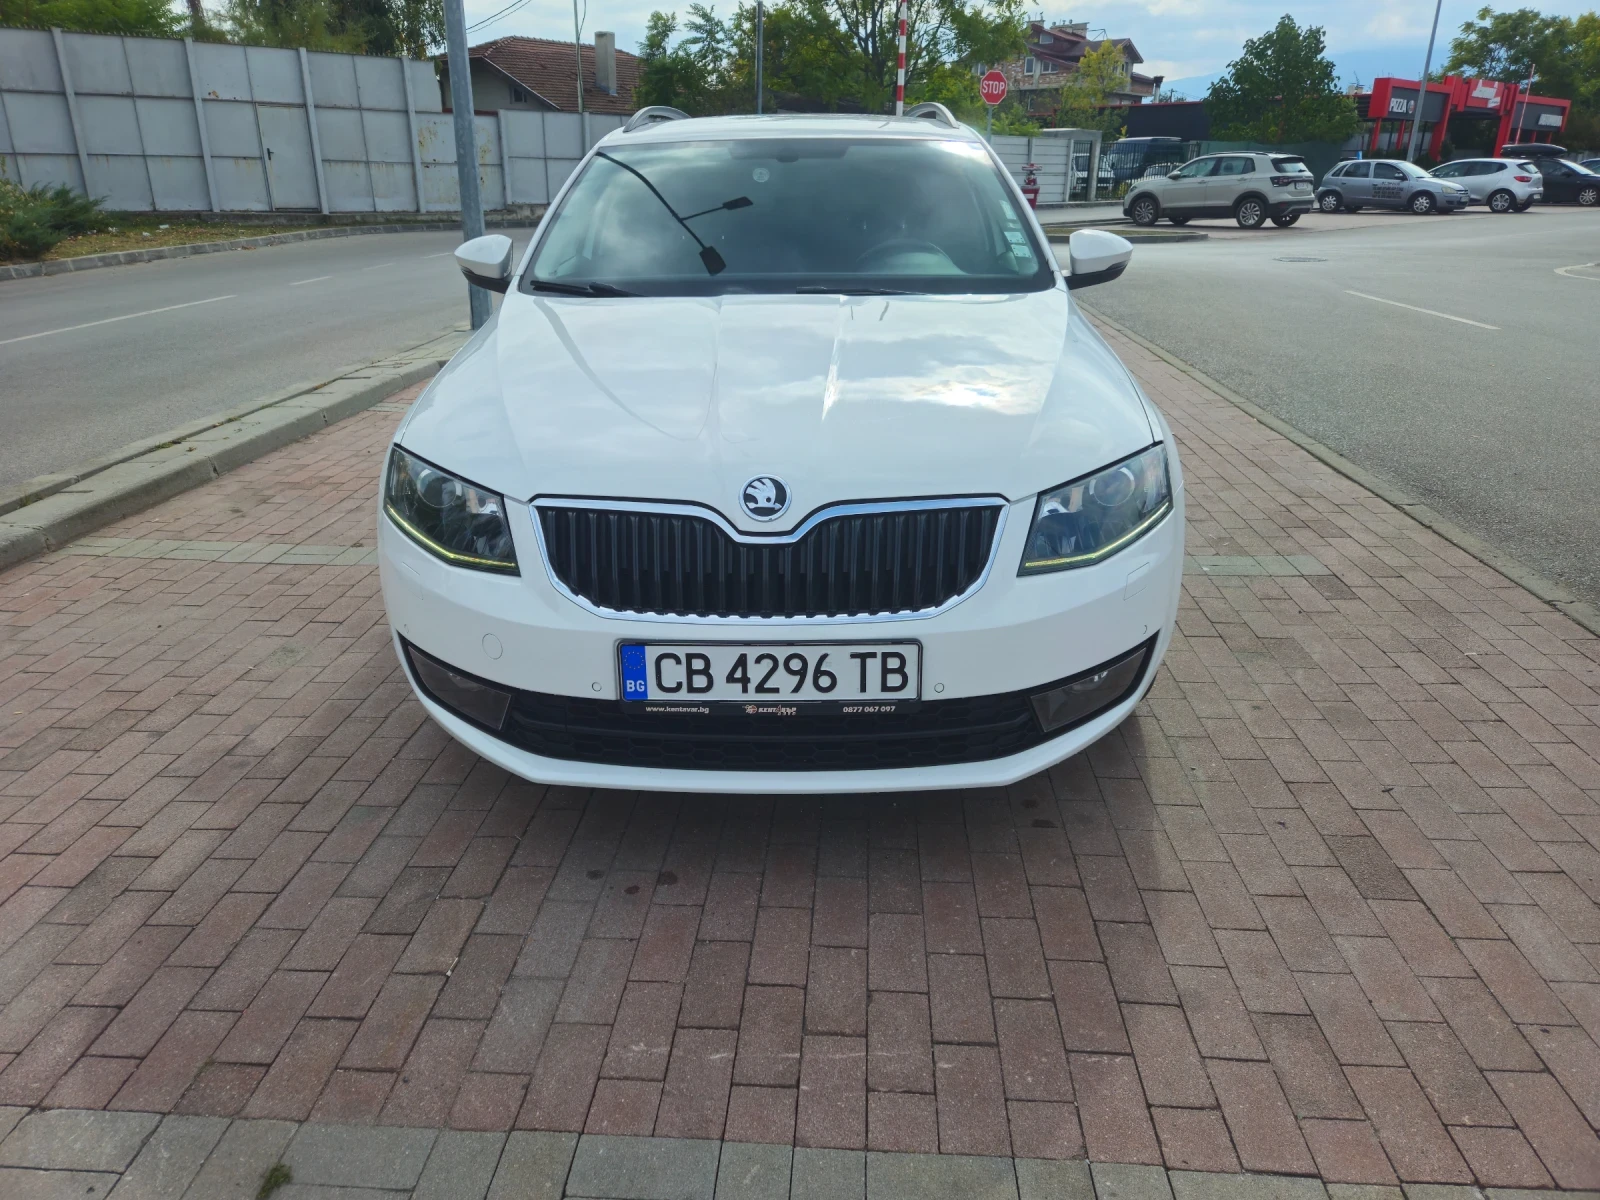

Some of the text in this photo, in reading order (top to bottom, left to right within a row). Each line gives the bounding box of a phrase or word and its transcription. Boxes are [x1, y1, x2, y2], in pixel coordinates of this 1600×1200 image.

[982, 81, 1005, 94] STOP
[1389, 97, 1407, 113] PIZZA
[655, 651, 909, 693] CB 4296 TB
[626, 680, 645, 692] BG
[645, 706, 709, 714] www.kentavar.bg
